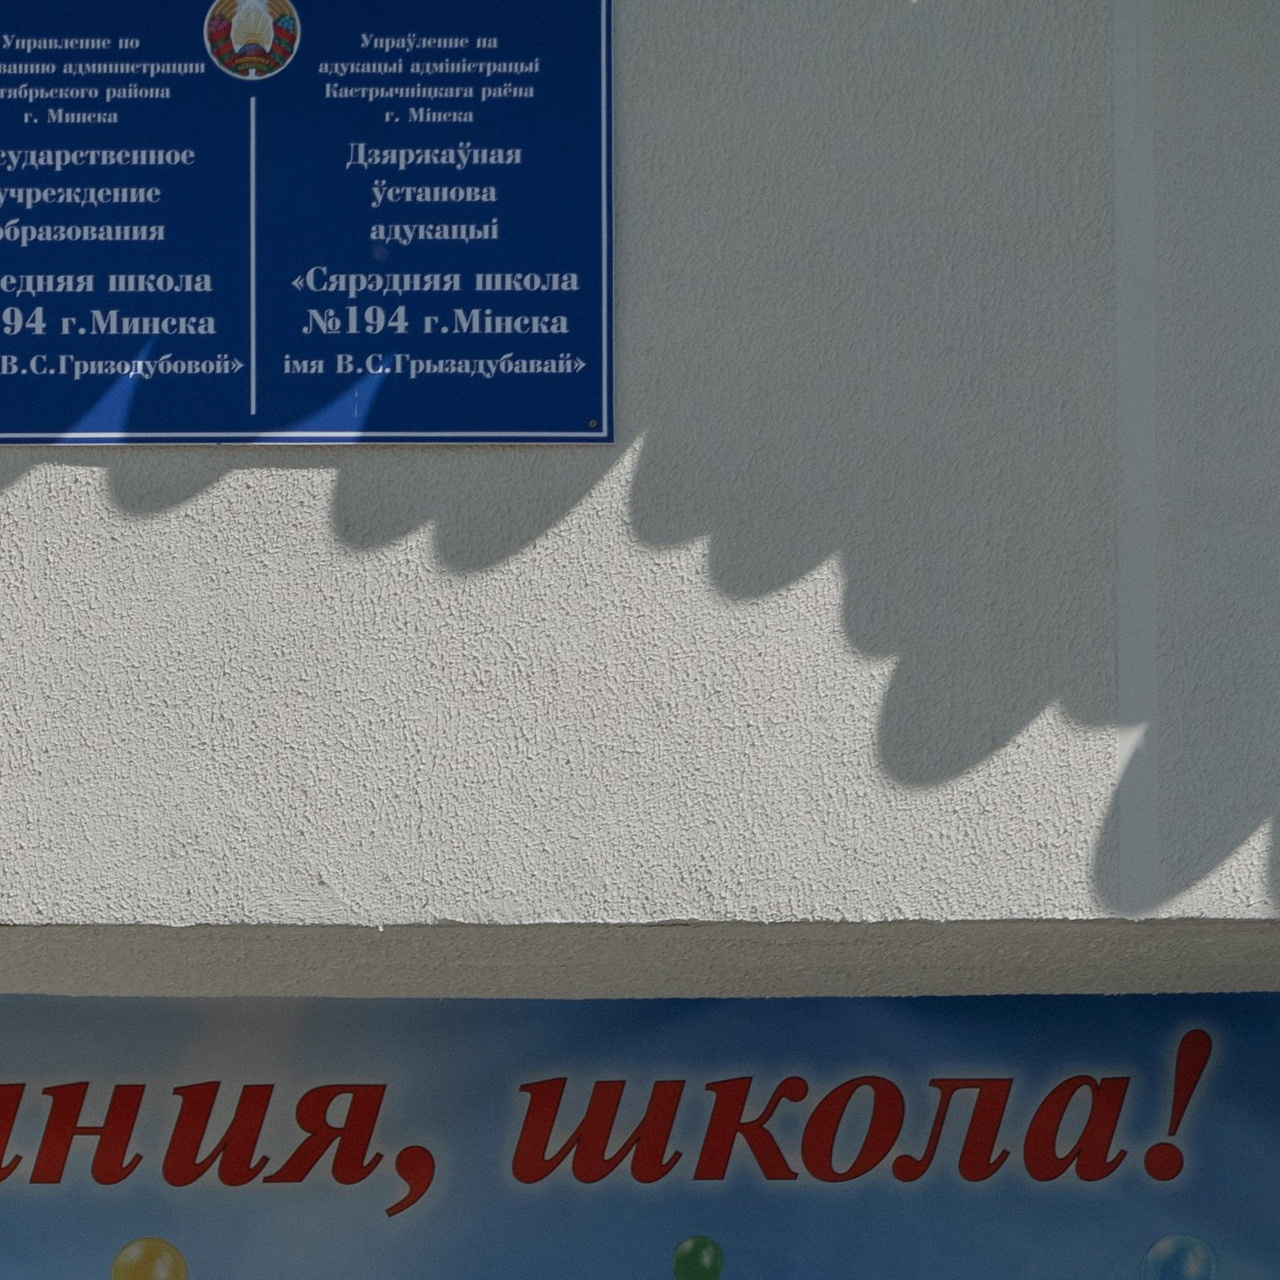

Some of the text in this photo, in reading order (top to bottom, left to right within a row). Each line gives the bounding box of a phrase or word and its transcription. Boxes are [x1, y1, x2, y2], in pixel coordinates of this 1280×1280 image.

[2, 34, 140, 53] Управление по
[361, 32, 469, 52] Упраўленне
[63, 59, 206, 79] администрации
[318, 57, 539, 77] адукацыі адміністрацыі
[106, 84, 170, 102] района
[325, 82, 534, 103] Кастрычніцкага раёна
[24, 109, 118, 124] г. Минска
[385, 107, 474, 123] г. Мінска
[346, 142, 522, 170] Дзяржаўная
[371, 181, 497, 208] ўстанова
[370, 217, 498, 246] адукацыі
[108, 274, 213, 293] школа
[291, 266, 579, 298] «Сярэдняя школа
[61, 310, 217, 336] г.Минска
[302, 306, 569, 335] №194 г.Мінска
[0, 353, 244, 380] В.С.Гризодубовой»
[284, 353, 586, 379] імя В.С.Грызадубавай»
[514, 1033, 1209, 1182] школа!
